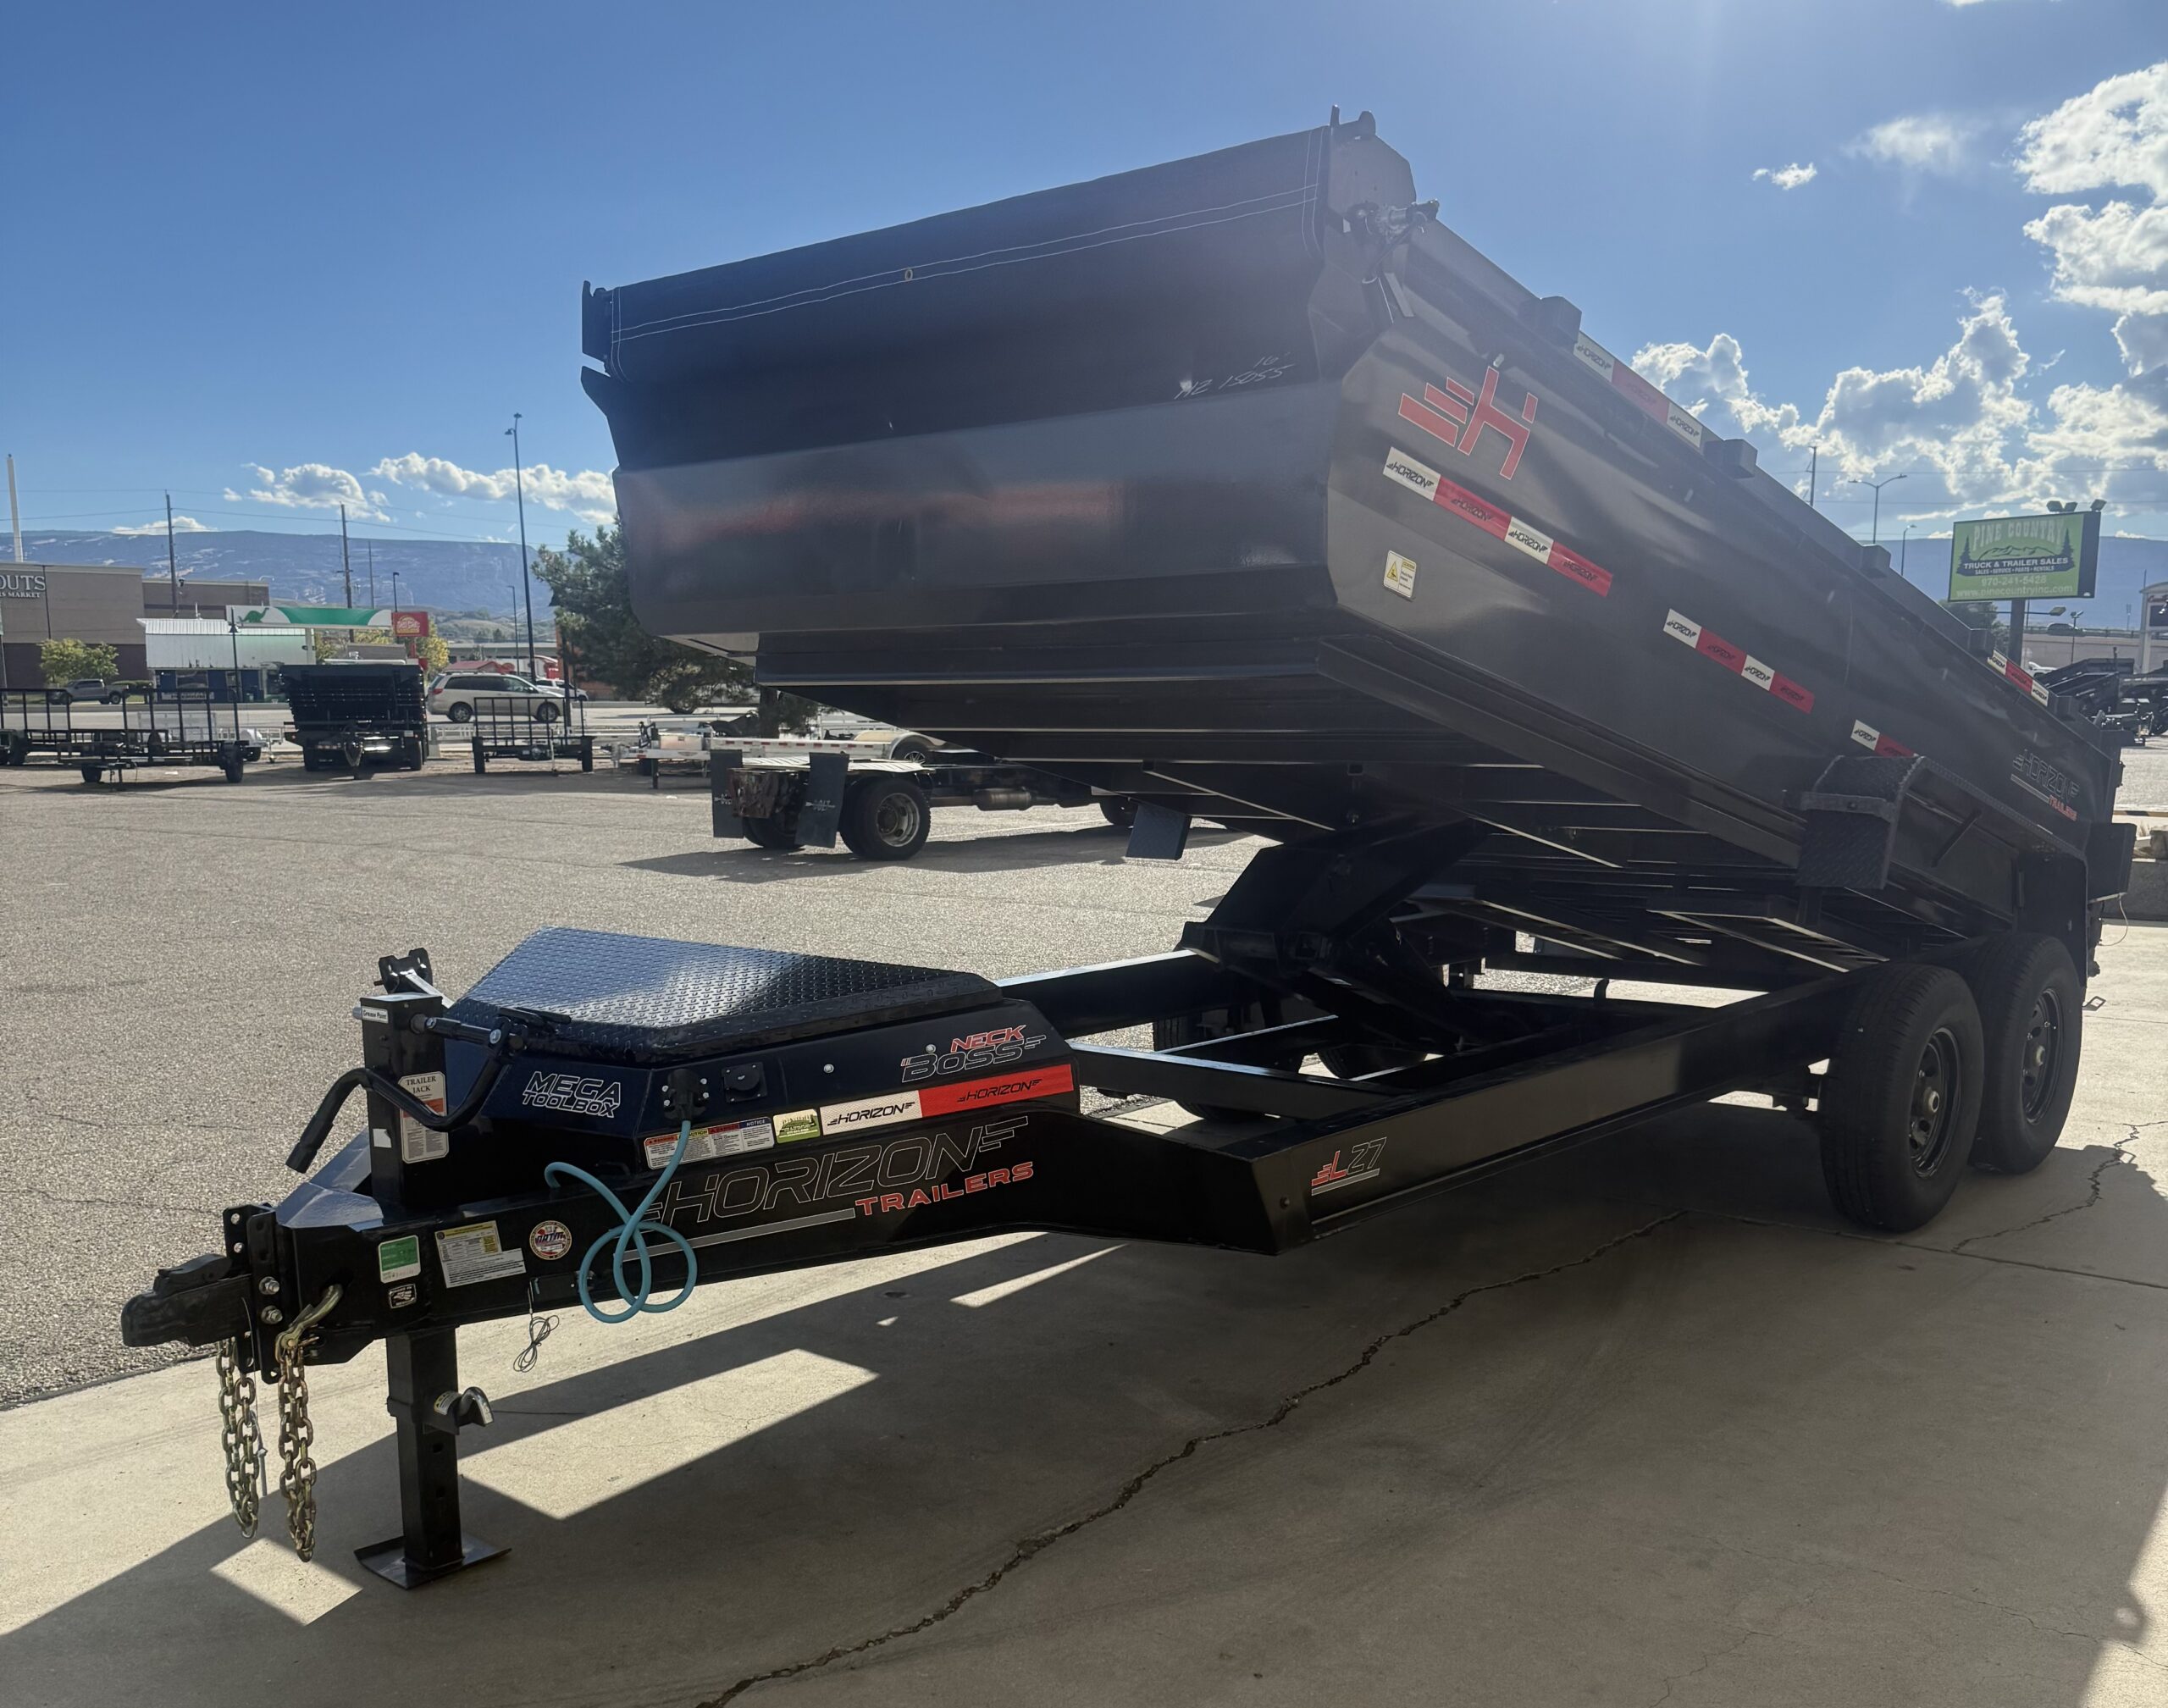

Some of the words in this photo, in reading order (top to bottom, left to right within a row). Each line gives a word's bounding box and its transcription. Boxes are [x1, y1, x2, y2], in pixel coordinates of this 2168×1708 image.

[1388, 461, 1433, 488] HORIZON
[1453, 496, 1491, 522] HORIZON
[1510, 530, 1548, 554] HORIZON
[1973, 522, 2002, 550] PINE
[2008, 518, 2065, 545] COUNTRY
[1964, 561, 1991, 570] TRUCK
[2003, 559, 2038, 567] TRAILER
[1956, 585, 2073, 597] www.pinecountryinc.com
[1981, 575, 2047, 586] 970-241-5428
[1667, 620, 1697, 638] HORIZON
[950, 1025, 1026, 1053] NECK
[901, 1037, 1026, 1083] BOSS
[406, 1075, 436, 1086] TRAILER
[412, 1085, 431, 1094] JACK
[525, 1070, 621, 1105] MEGA
[964, 1080, 1035, 1102] HORIZON
[522, 1089, 620, 1118] TOOLBOX
[833, 1103, 909, 1125] HORIZON
[661, 1122, 989, 1228] HORIZON
[855, 1161, 1034, 1216] TRAILERS
